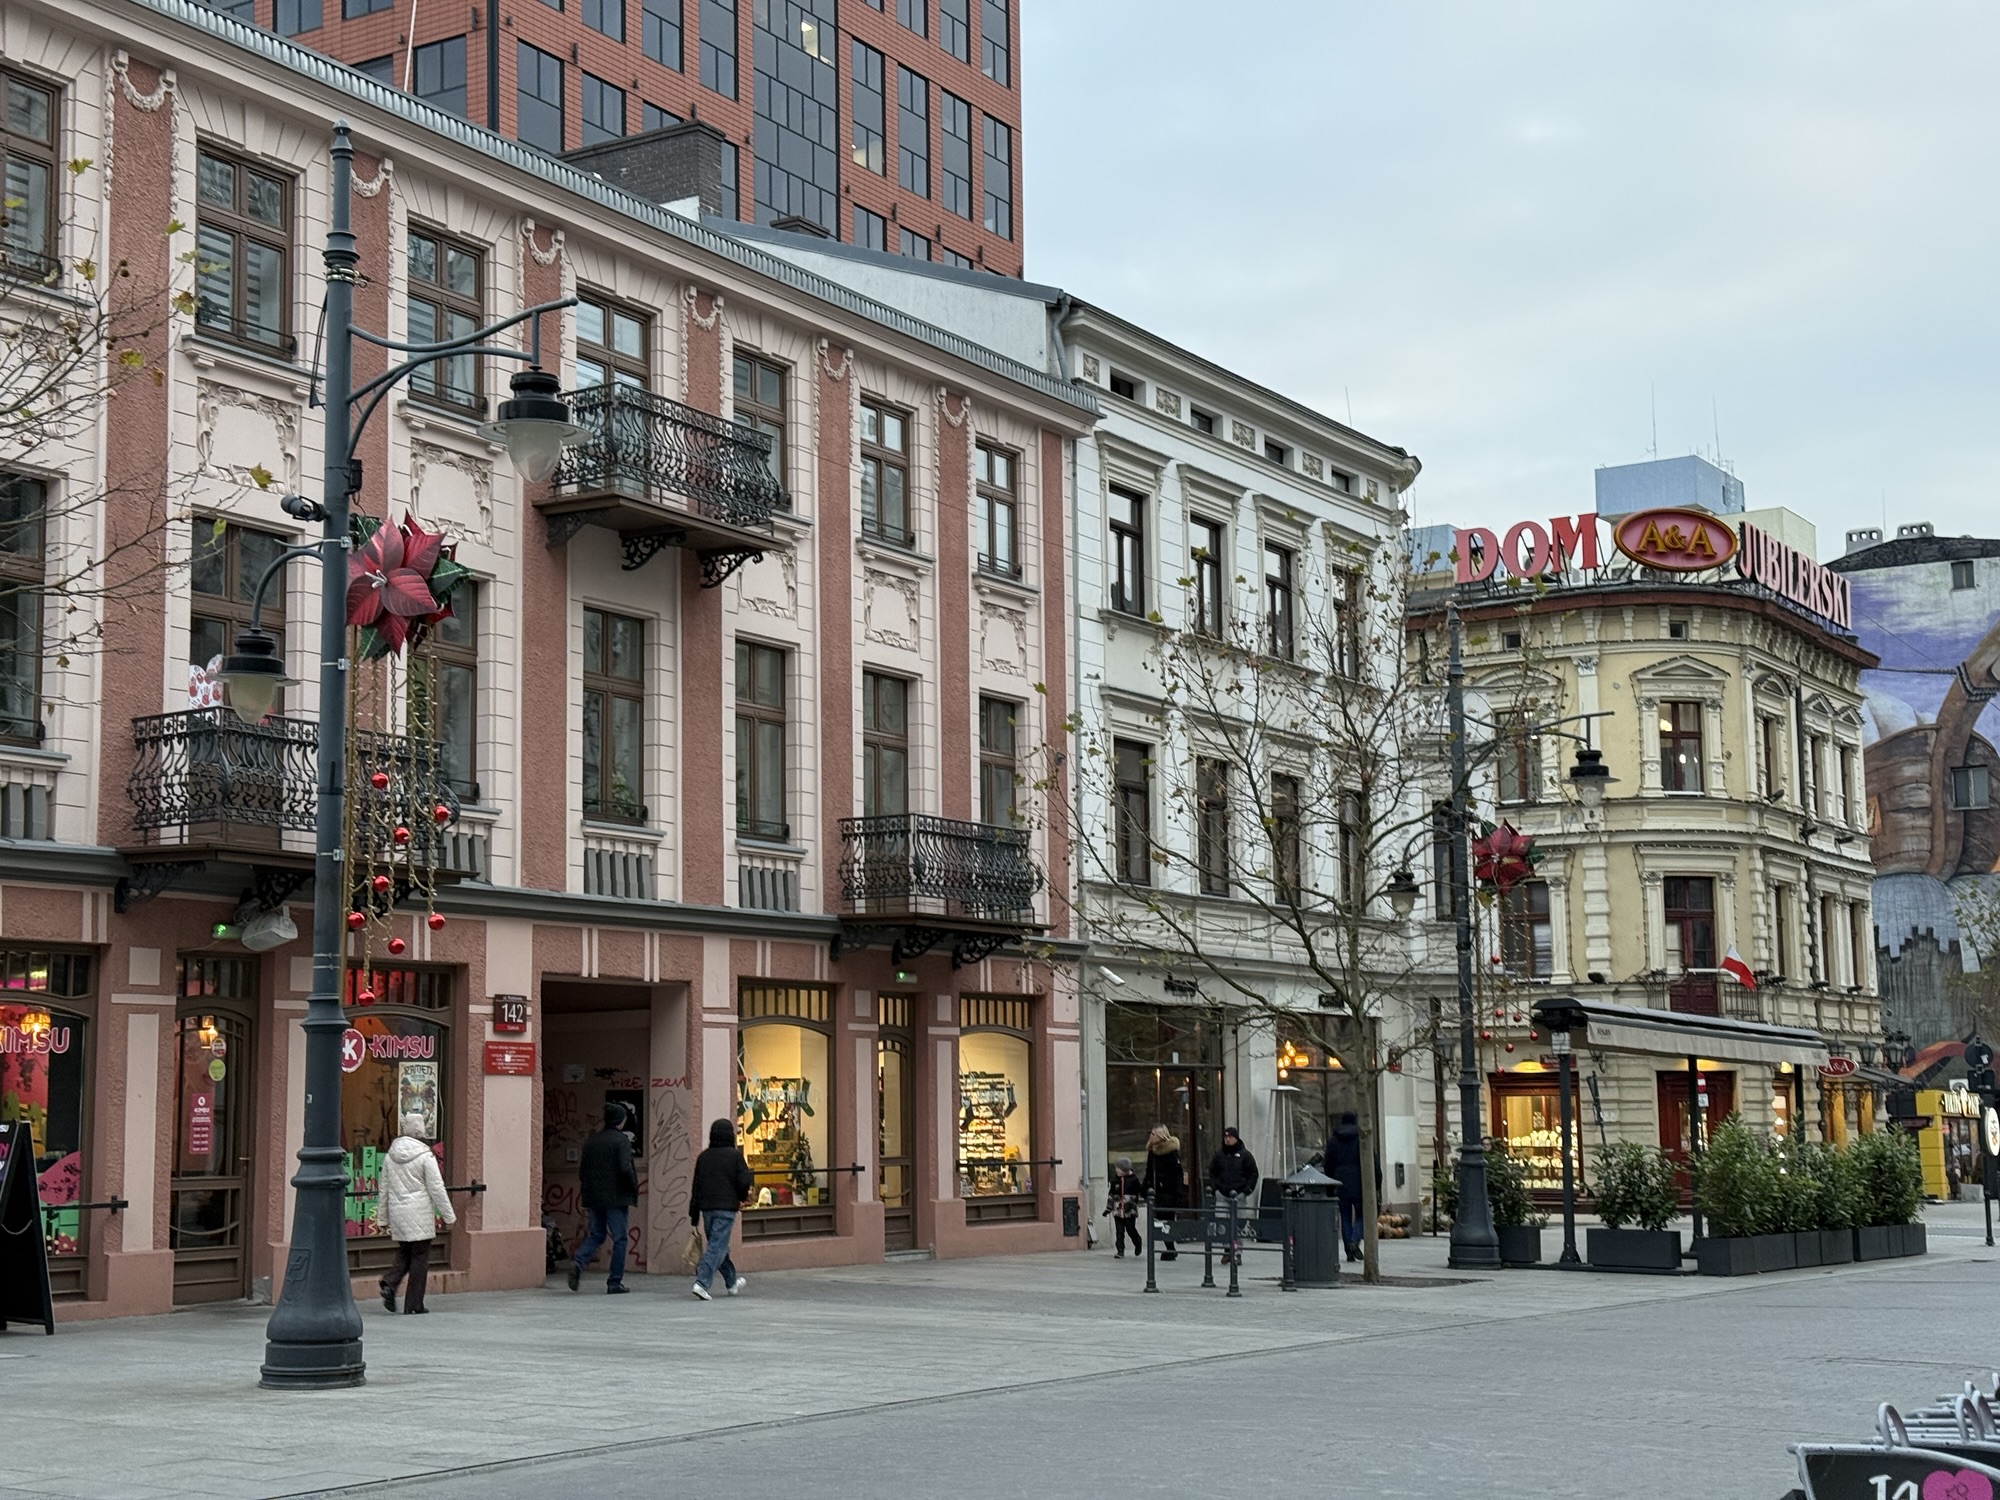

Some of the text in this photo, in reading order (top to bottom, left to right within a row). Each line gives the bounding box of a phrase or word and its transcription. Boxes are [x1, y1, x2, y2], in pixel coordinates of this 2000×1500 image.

[1452, 512, 1852, 631] DOM A&A JUBILERSKI
[501, 1002, 524, 1023] 142
[0, 1026, 71, 1054] IMSU
[367, 1034, 435, 1059] KIMSU
